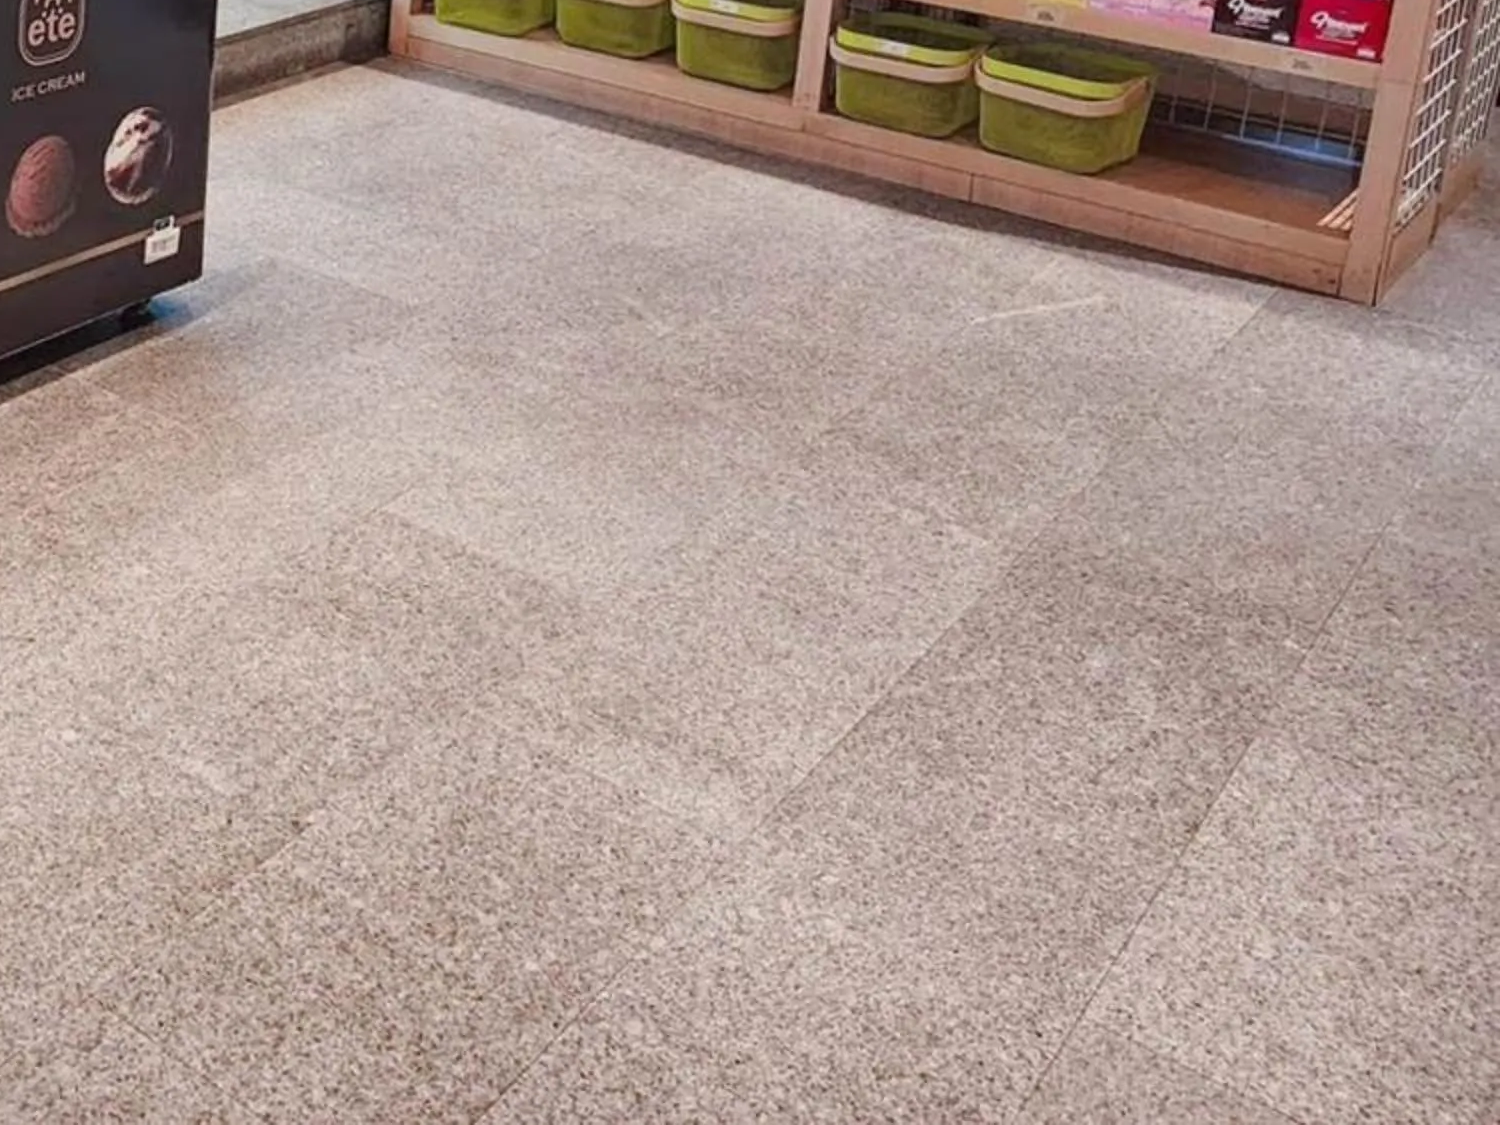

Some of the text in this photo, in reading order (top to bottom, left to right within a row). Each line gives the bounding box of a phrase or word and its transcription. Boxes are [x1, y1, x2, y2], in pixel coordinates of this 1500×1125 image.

[27, 8, 77, 47] ete
[10, 71, 86, 103] ICE CREAM
